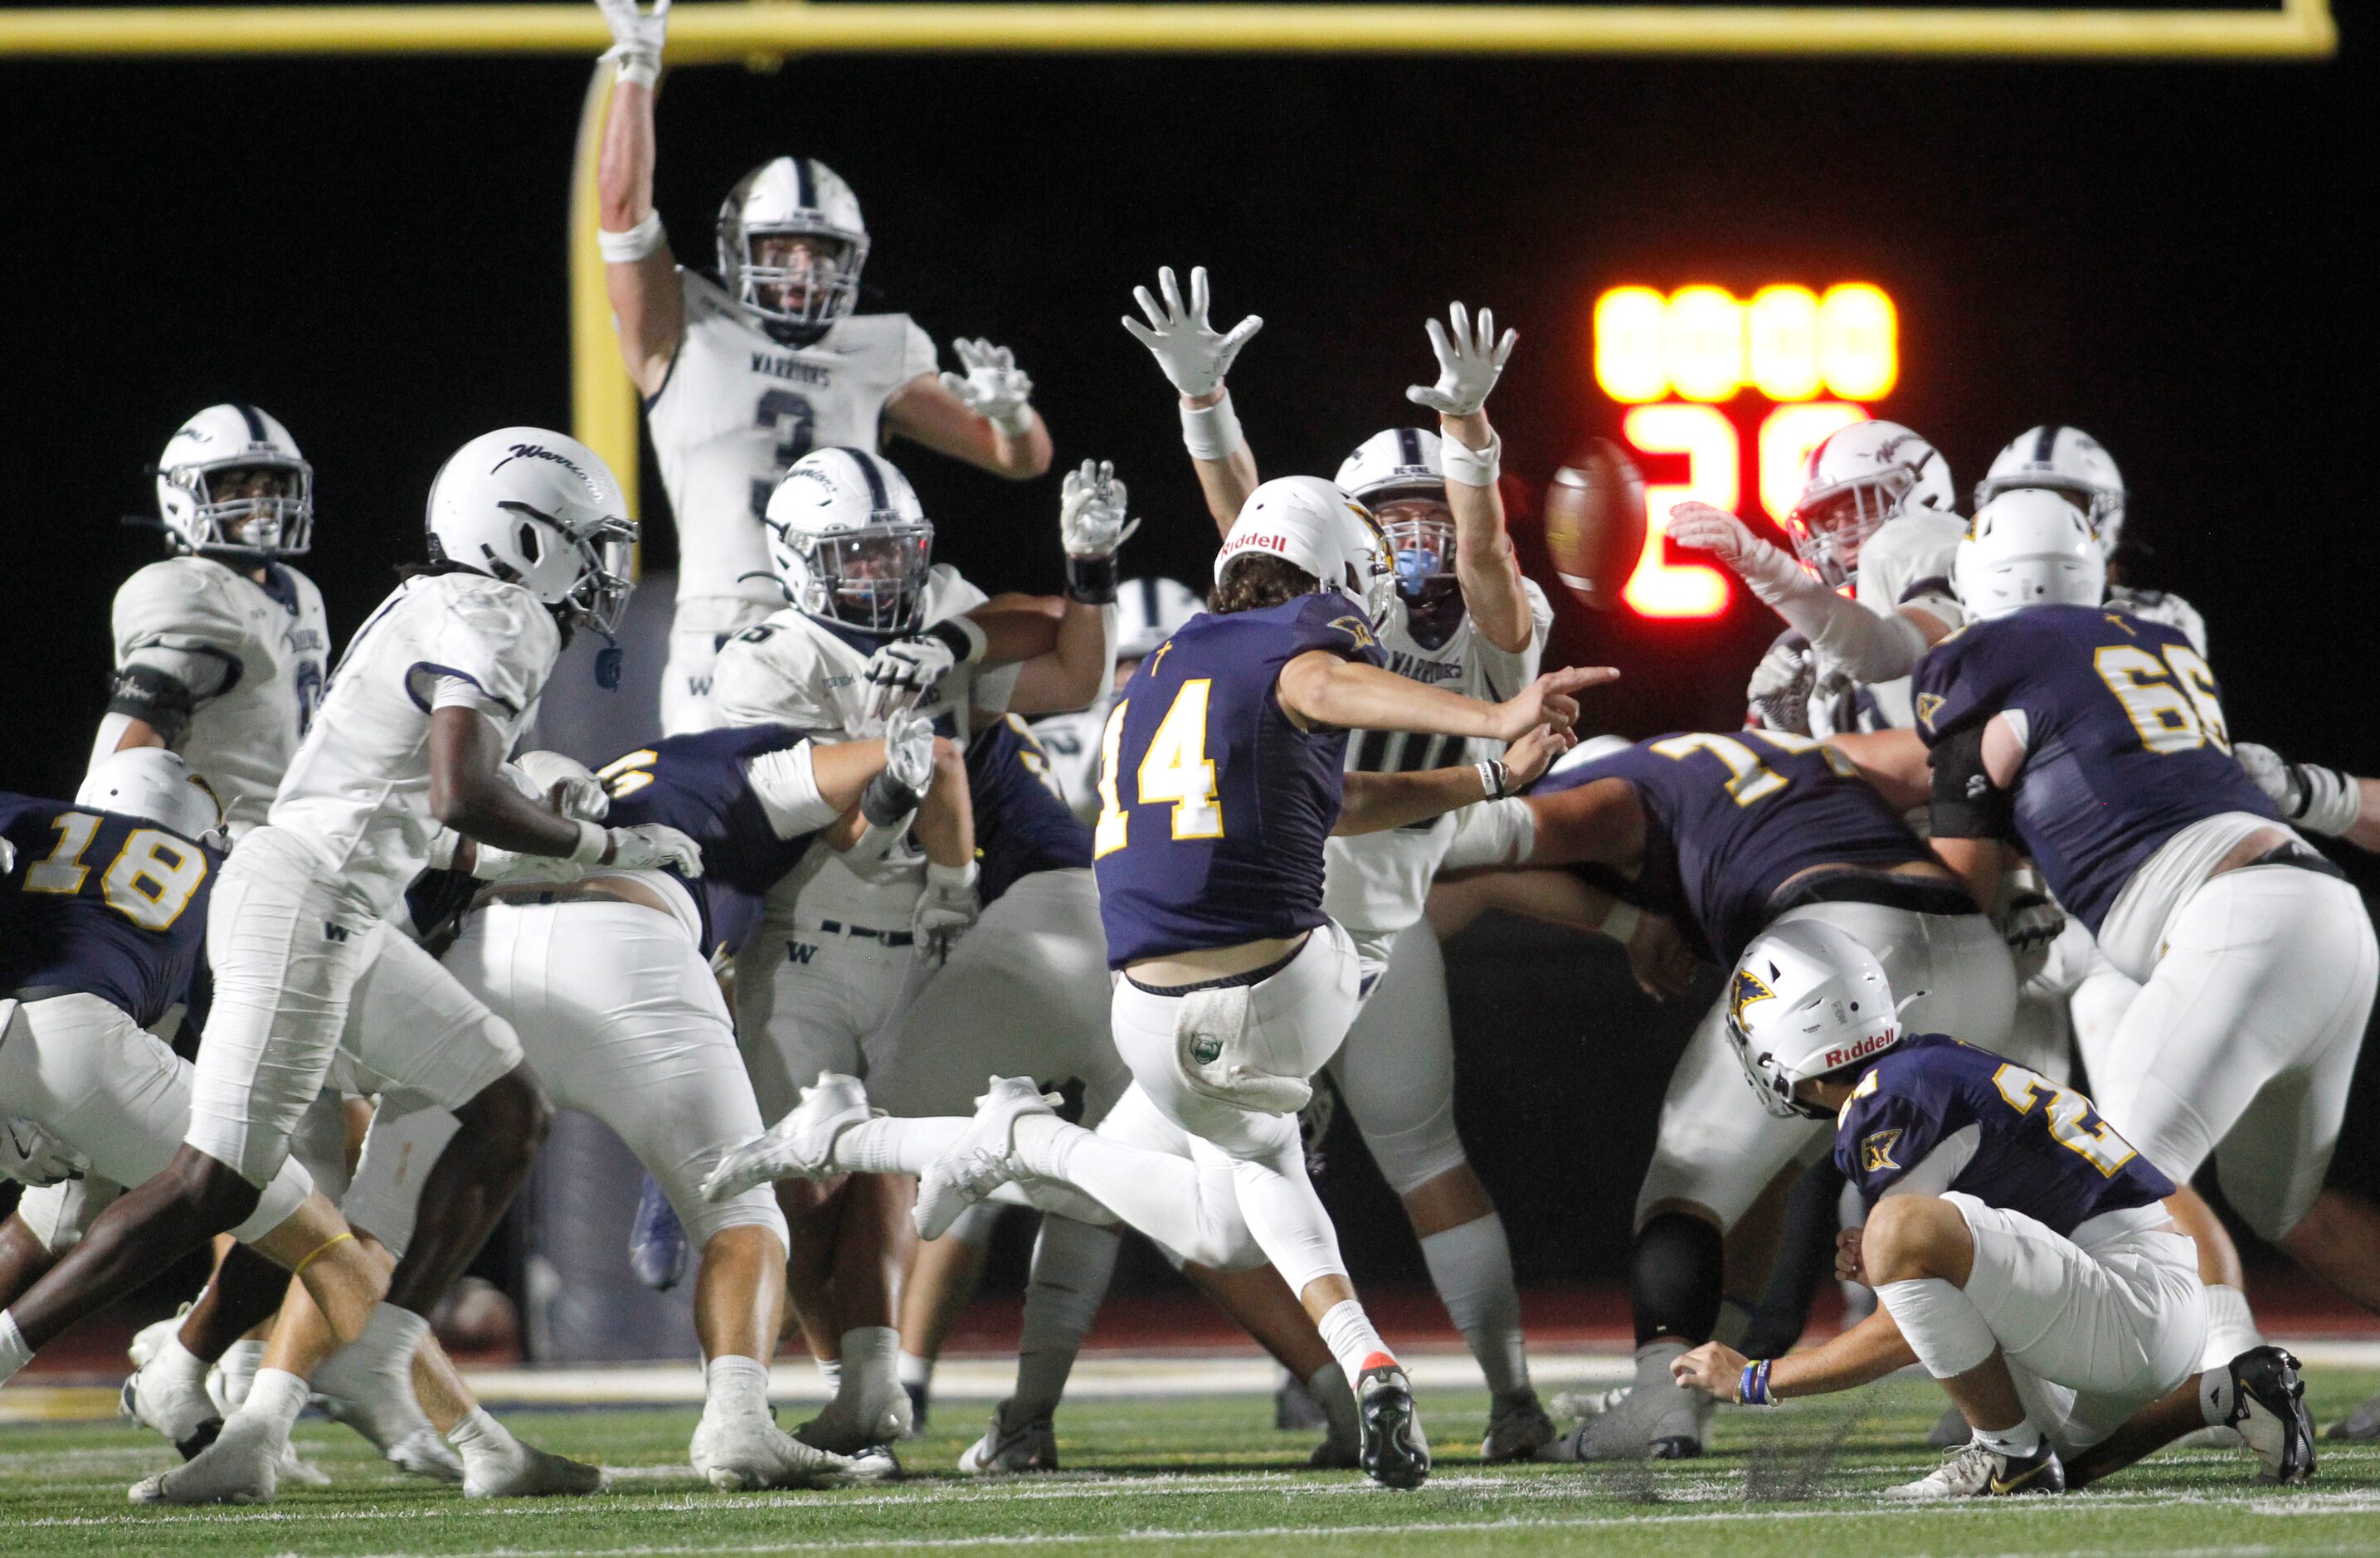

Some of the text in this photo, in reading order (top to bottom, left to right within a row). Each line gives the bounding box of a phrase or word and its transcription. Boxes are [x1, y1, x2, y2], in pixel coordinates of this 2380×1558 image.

[1221, 533, 1287, 558] Riddell
[689, 676, 713, 696] W
[1093, 678, 1224, 860] 14
[22, 811, 207, 931] 18
[786, 941, 819, 965] W
[1825, 1028, 1895, 1069] Riddell
